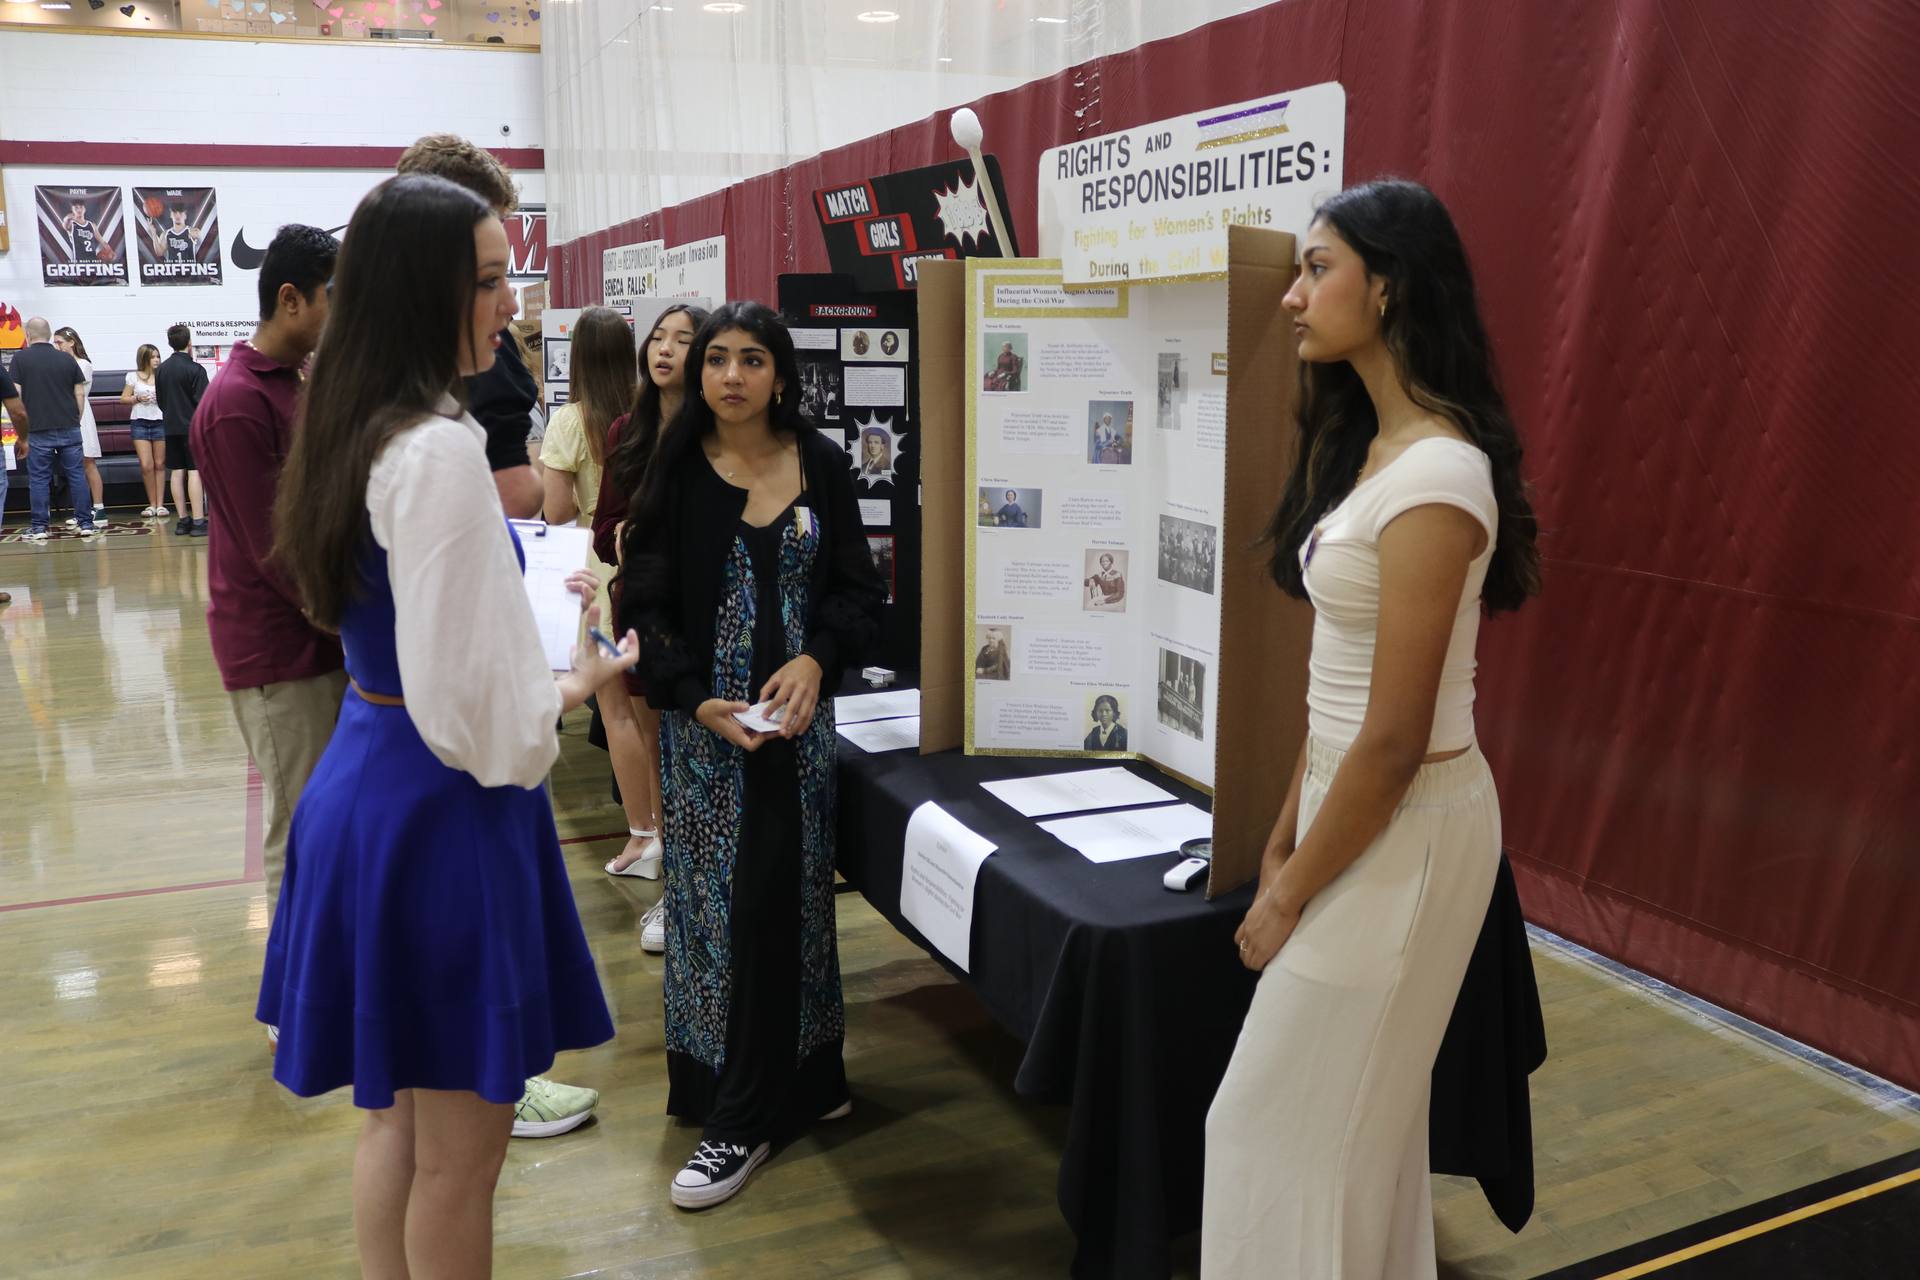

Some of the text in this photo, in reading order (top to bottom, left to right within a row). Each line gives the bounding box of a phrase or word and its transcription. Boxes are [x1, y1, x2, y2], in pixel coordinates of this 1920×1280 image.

[1057, 132, 1172, 180] RIGHTS AND
[1082, 141, 1330, 213] RESPONSIBILITIES:
[826, 186, 870, 218] MATCH
[870, 220, 900, 249] GIRLS
[1074, 204, 1272, 253] Fighting for Women's Rights
[84, 240, 93, 252] 2
[176, 252, 182, 261] 1
[667, 251, 686, 269] German
[689, 240, 718, 263] Invasion
[46, 263, 125, 277] GRIFFINS
[143, 263, 219, 277] GRIFFINS
[1090, 260, 1129, 279] During
[1140, 256, 1159, 274] the
[605, 276, 646, 297] SENECA FALLS
[997, 287, 1031, 295] Influential
[1033, 287, 1063, 295] Women's
[815, 305, 872, 317] BACKGROUND
